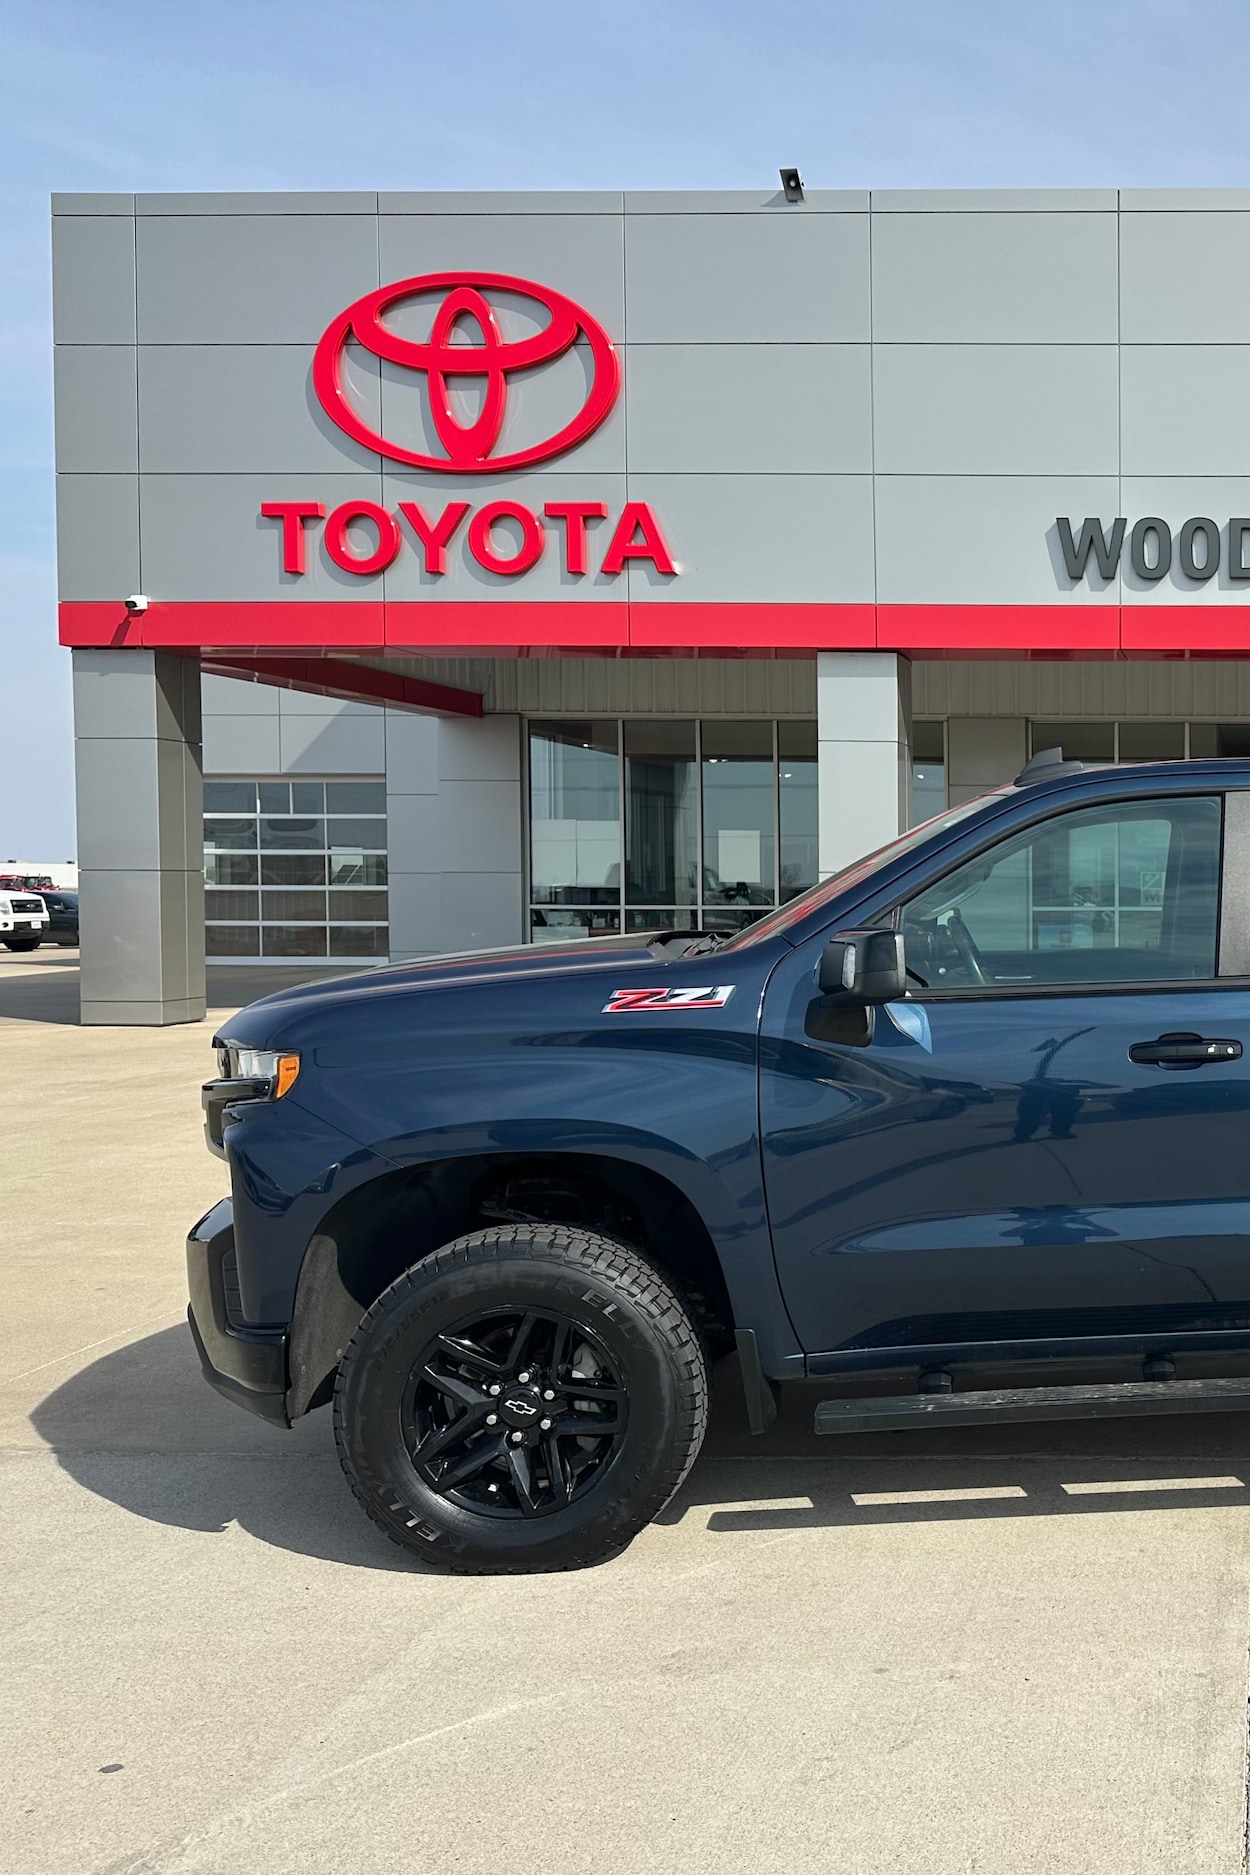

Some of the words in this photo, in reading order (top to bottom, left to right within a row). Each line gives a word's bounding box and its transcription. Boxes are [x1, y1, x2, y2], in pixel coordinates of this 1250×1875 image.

[261, 500, 679, 575] TOYOTA
[601, 985, 736, 1013] Z71
[554, 1274, 655, 1353] KELLY
[368, 1480, 472, 1554] KELLY
